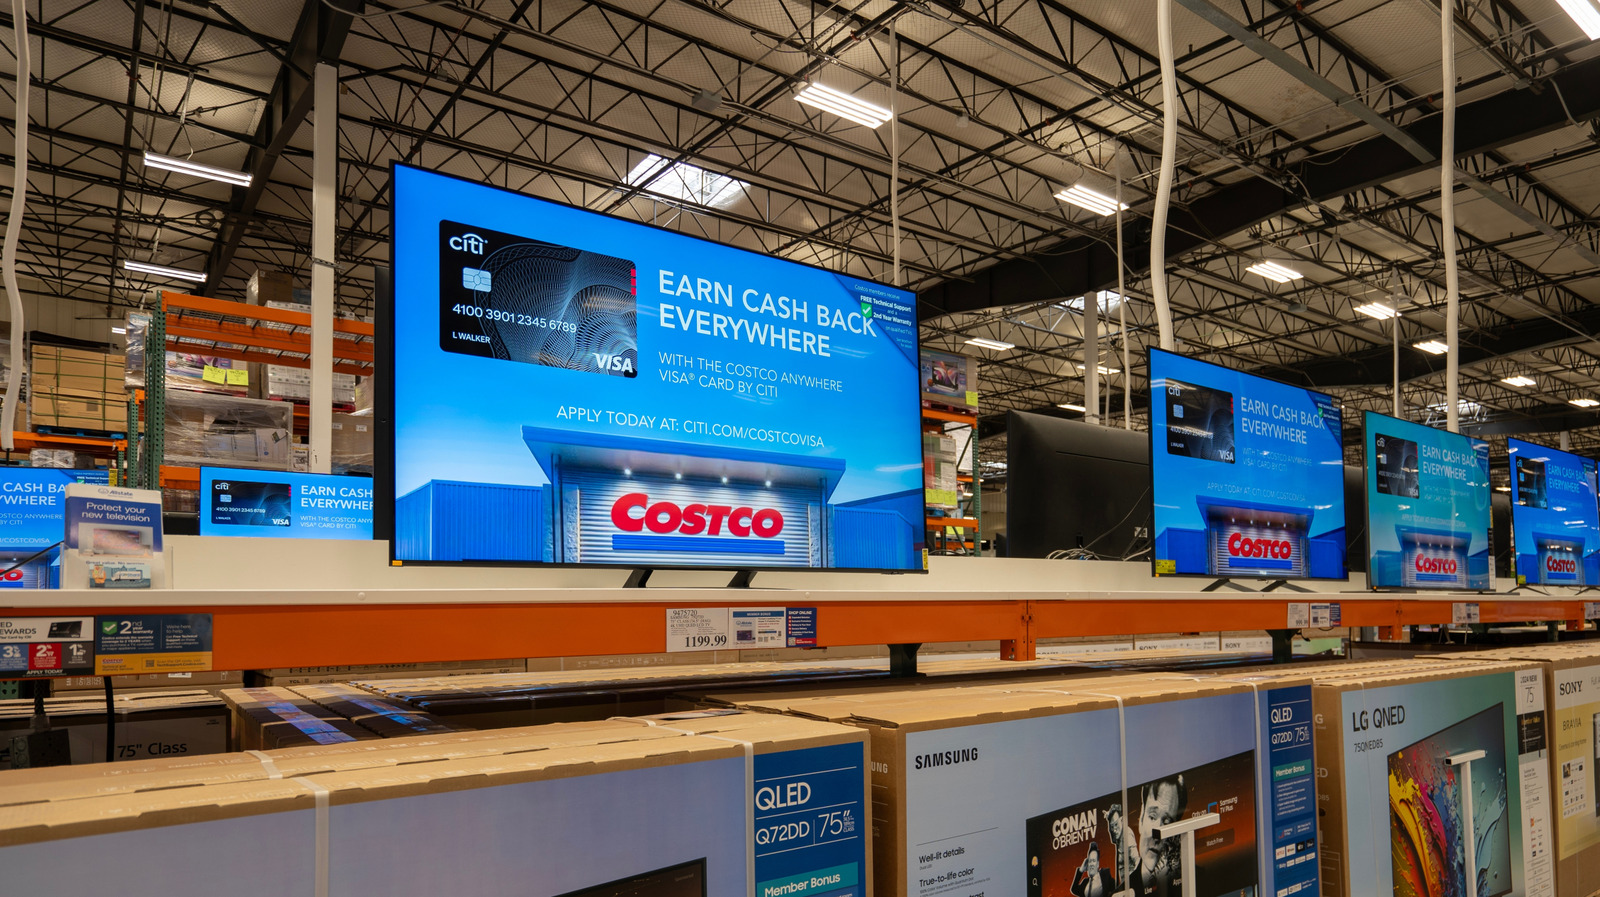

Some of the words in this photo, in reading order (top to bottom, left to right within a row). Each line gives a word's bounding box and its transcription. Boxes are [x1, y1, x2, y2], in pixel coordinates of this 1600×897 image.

[449, 233, 486, 255] citi
[659, 269, 733, 307] EARN
[742, 288, 808, 323] CASH
[817, 304, 877, 338] BACK
[860, 295, 873, 303] FREE
[873, 298, 893, 308] Technical
[894, 303, 912, 312] Support
[452, 304, 483, 318] 4100
[485, 308, 515, 322] 3901
[518, 314, 547, 329] 2345
[549, 320, 577, 333] 6789
[883, 314, 893, 322] Year
[893, 316, 912, 327] Warranty
[458, 332, 491, 344] WALKER
[660, 303, 831, 357] EVERYWHERE
[592, 352, 634, 373] VISA
[658, 352, 693, 368] WITH
[697, 357, 722, 373] THE
[726, 362, 778, 382] COSTCO
[781, 371, 843, 392] ANYWHERE
[699, 375, 734, 391] CARD
[738, 381, 753, 394] BY
[756, 384, 778, 398] CITI
[1241, 397, 1269, 417] EARN
[1272, 405, 1298, 423] CASH
[1301, 411, 1326, 430] BACK
[556, 405, 602, 423] APPLY
[606, 410, 656, 429] TODAY
[660, 417, 679, 431] AT:
[683, 420, 825, 448] CITI.COM/COSTCOVISA
[1242, 418, 1307, 445] EVERYWHERE
[1219, 450, 1234, 461] VISA
[1423, 445, 1442, 460] EARN
[1442, 450, 1460, 464] CASH
[1462, 454, 1479, 468] BACK
[1423, 462, 1467, 482] EVERYWHERE
[3, 482, 44, 493] CASH
[48, 484, 66, 493] BA
[301, 486, 336, 496] EARN
[340, 487, 373, 499] CASH
[0, 495, 56, 506] YWHERE
[86, 502, 122, 513] Protect
[124, 506, 146, 515] your
[301, 498, 373, 511] EVERYWHE
[82, 511, 103, 520] new
[106, 512, 151, 522] television
[272, 518, 289, 526] VISA
[685, 635, 727, 648] 1199.99
[1559, 680, 1583, 696] SONY
[1271, 707, 1292, 724] QLED
[1353, 710, 1369, 732] LG
[1373, 705, 1406, 729] QNED
[1563, 718, 1582, 731] BRAVIA
[1272, 730, 1293, 745] Q72DD
[1354, 739, 1384, 753] 75QNED85
[117, 744, 143, 758] 75"
[147, 740, 187, 756] Class
[915, 747, 978, 770] SAMSUNG
[1276, 767, 1294, 778] Member
[1294, 765, 1306, 774] Bonus
[756, 782, 812, 811] QLED
[1219, 796, 1238, 807] Samsung
[1052, 808, 1097, 838] CONAN
[756, 821, 810, 845] Q72DD
[919, 852, 942, 864] Well-lit
[943, 847, 965, 858] details
[765, 881, 809, 897] Member
[810, 874, 841, 888] Bonus
[920, 872, 957, 888] True-to-life
[958, 867, 975, 878] color
[1173, 879, 1182, 887] App
[1144, 887, 1153, 895] Live
